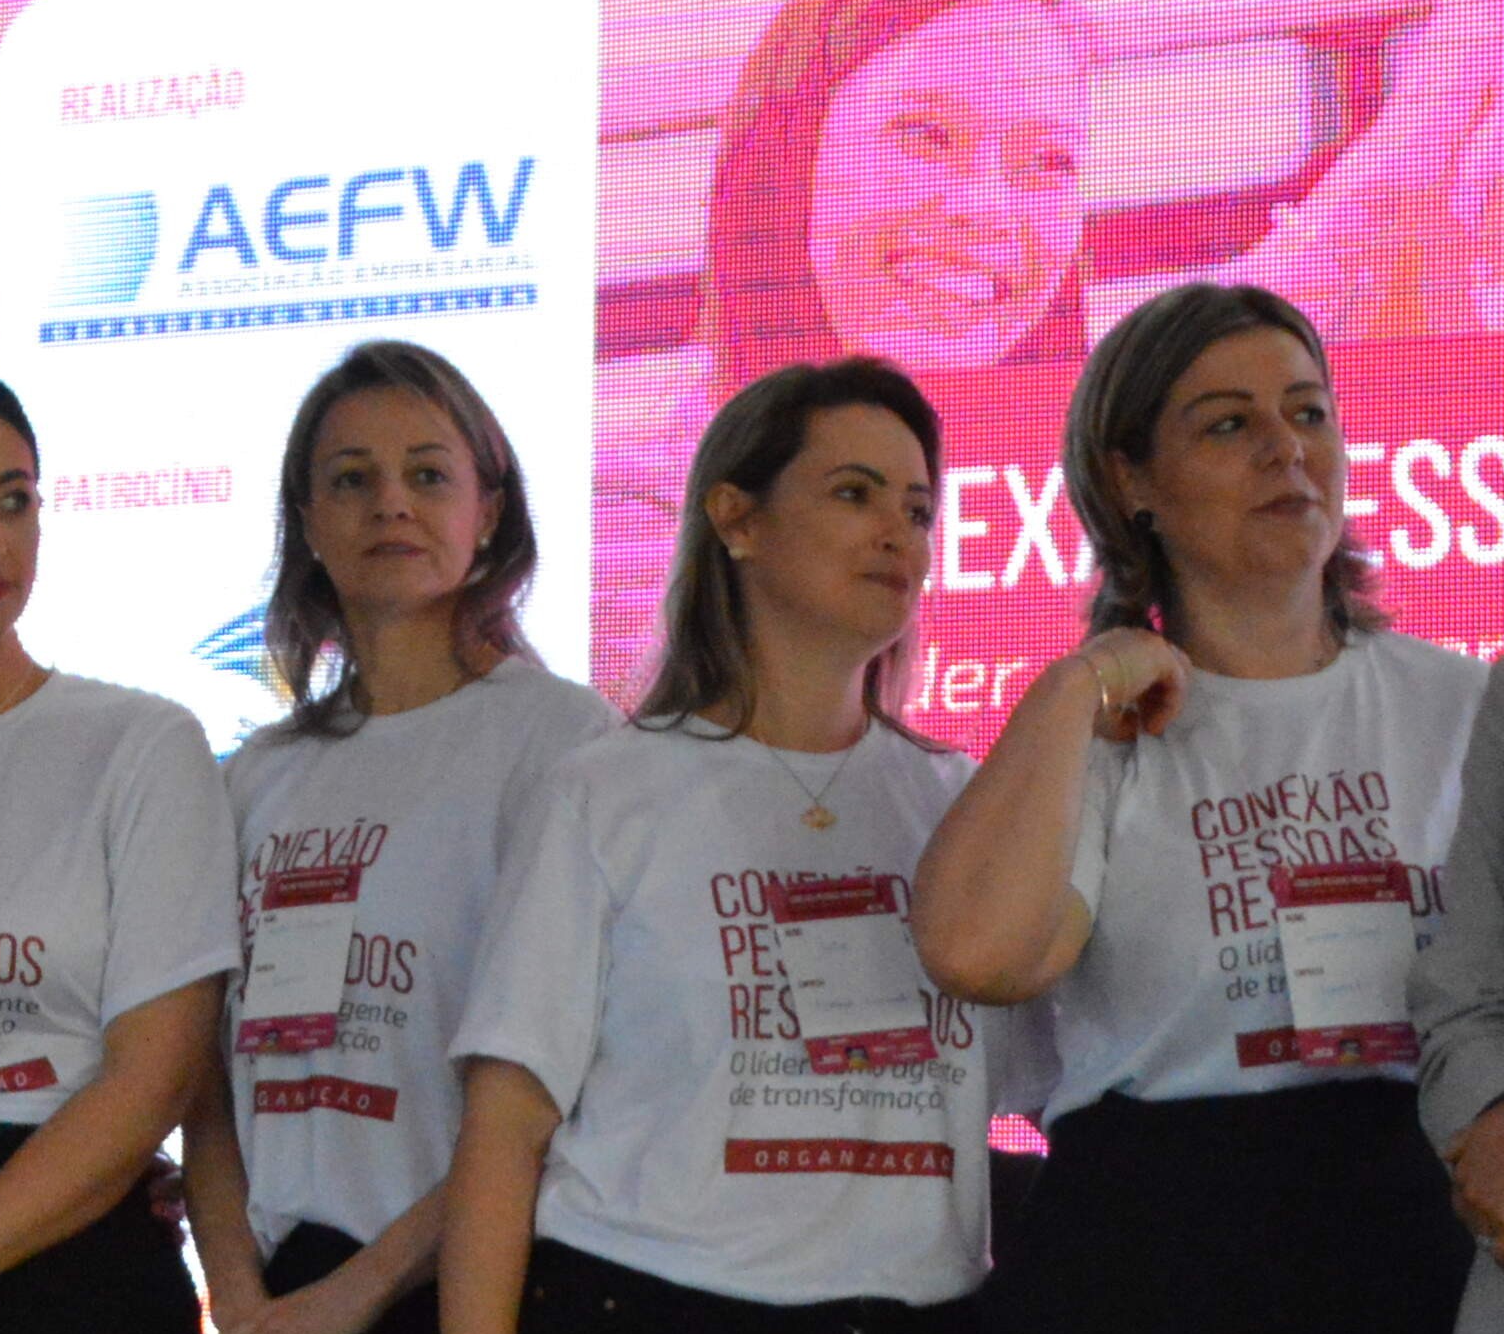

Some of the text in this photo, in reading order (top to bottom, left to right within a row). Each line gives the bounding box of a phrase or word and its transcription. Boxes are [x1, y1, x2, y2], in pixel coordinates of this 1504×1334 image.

[59, 65, 246, 126] REALIZAÇÃO
[177, 155, 538, 275] AEFW
[53, 463, 232, 515] PATROCÍNIO
[1191, 769, 1391, 842] CONEXÃO
[1198, 816, 1398, 879] PESSOAS
[1219, 945, 1239, 972] O
[1226, 979, 1260, 1002] de
[729, 1051, 746, 1075] O
[751, 1050, 808, 1076] líder
[729, 1080, 946, 1115] de transformaçã
